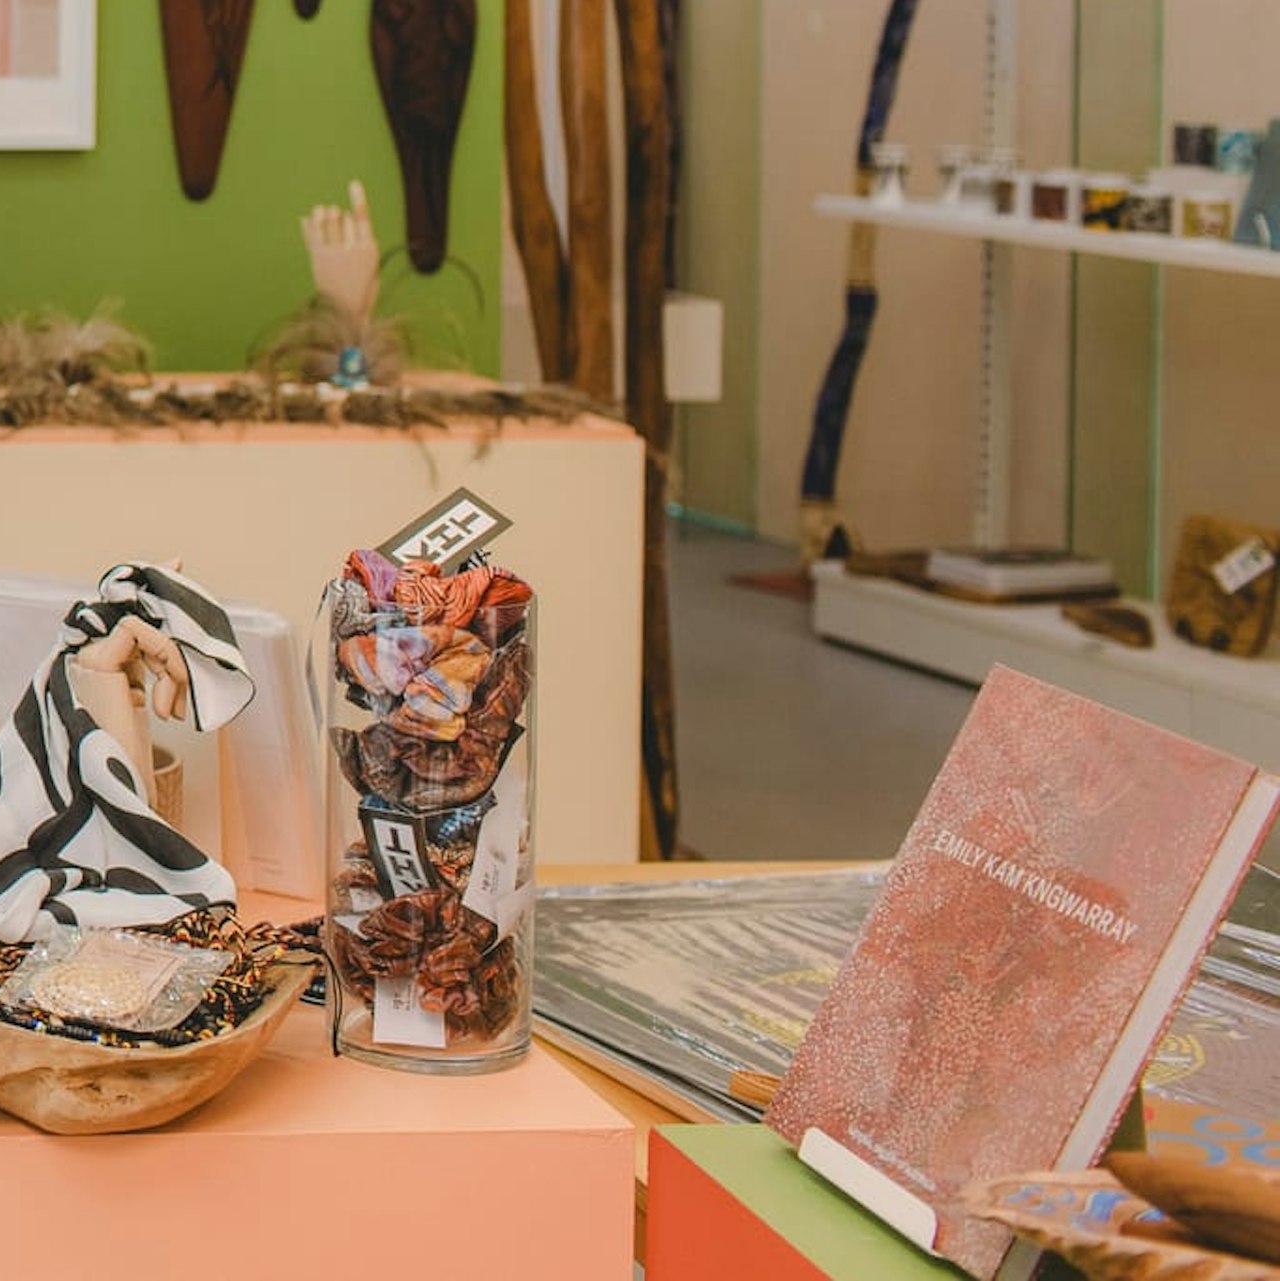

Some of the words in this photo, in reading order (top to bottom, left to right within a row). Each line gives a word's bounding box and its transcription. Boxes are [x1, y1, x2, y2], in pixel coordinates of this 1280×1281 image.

[935, 829, 988, 869] EMILY
[982, 853, 1026, 891] KAM
[1023, 872, 1139, 945] KNGWARRAY
